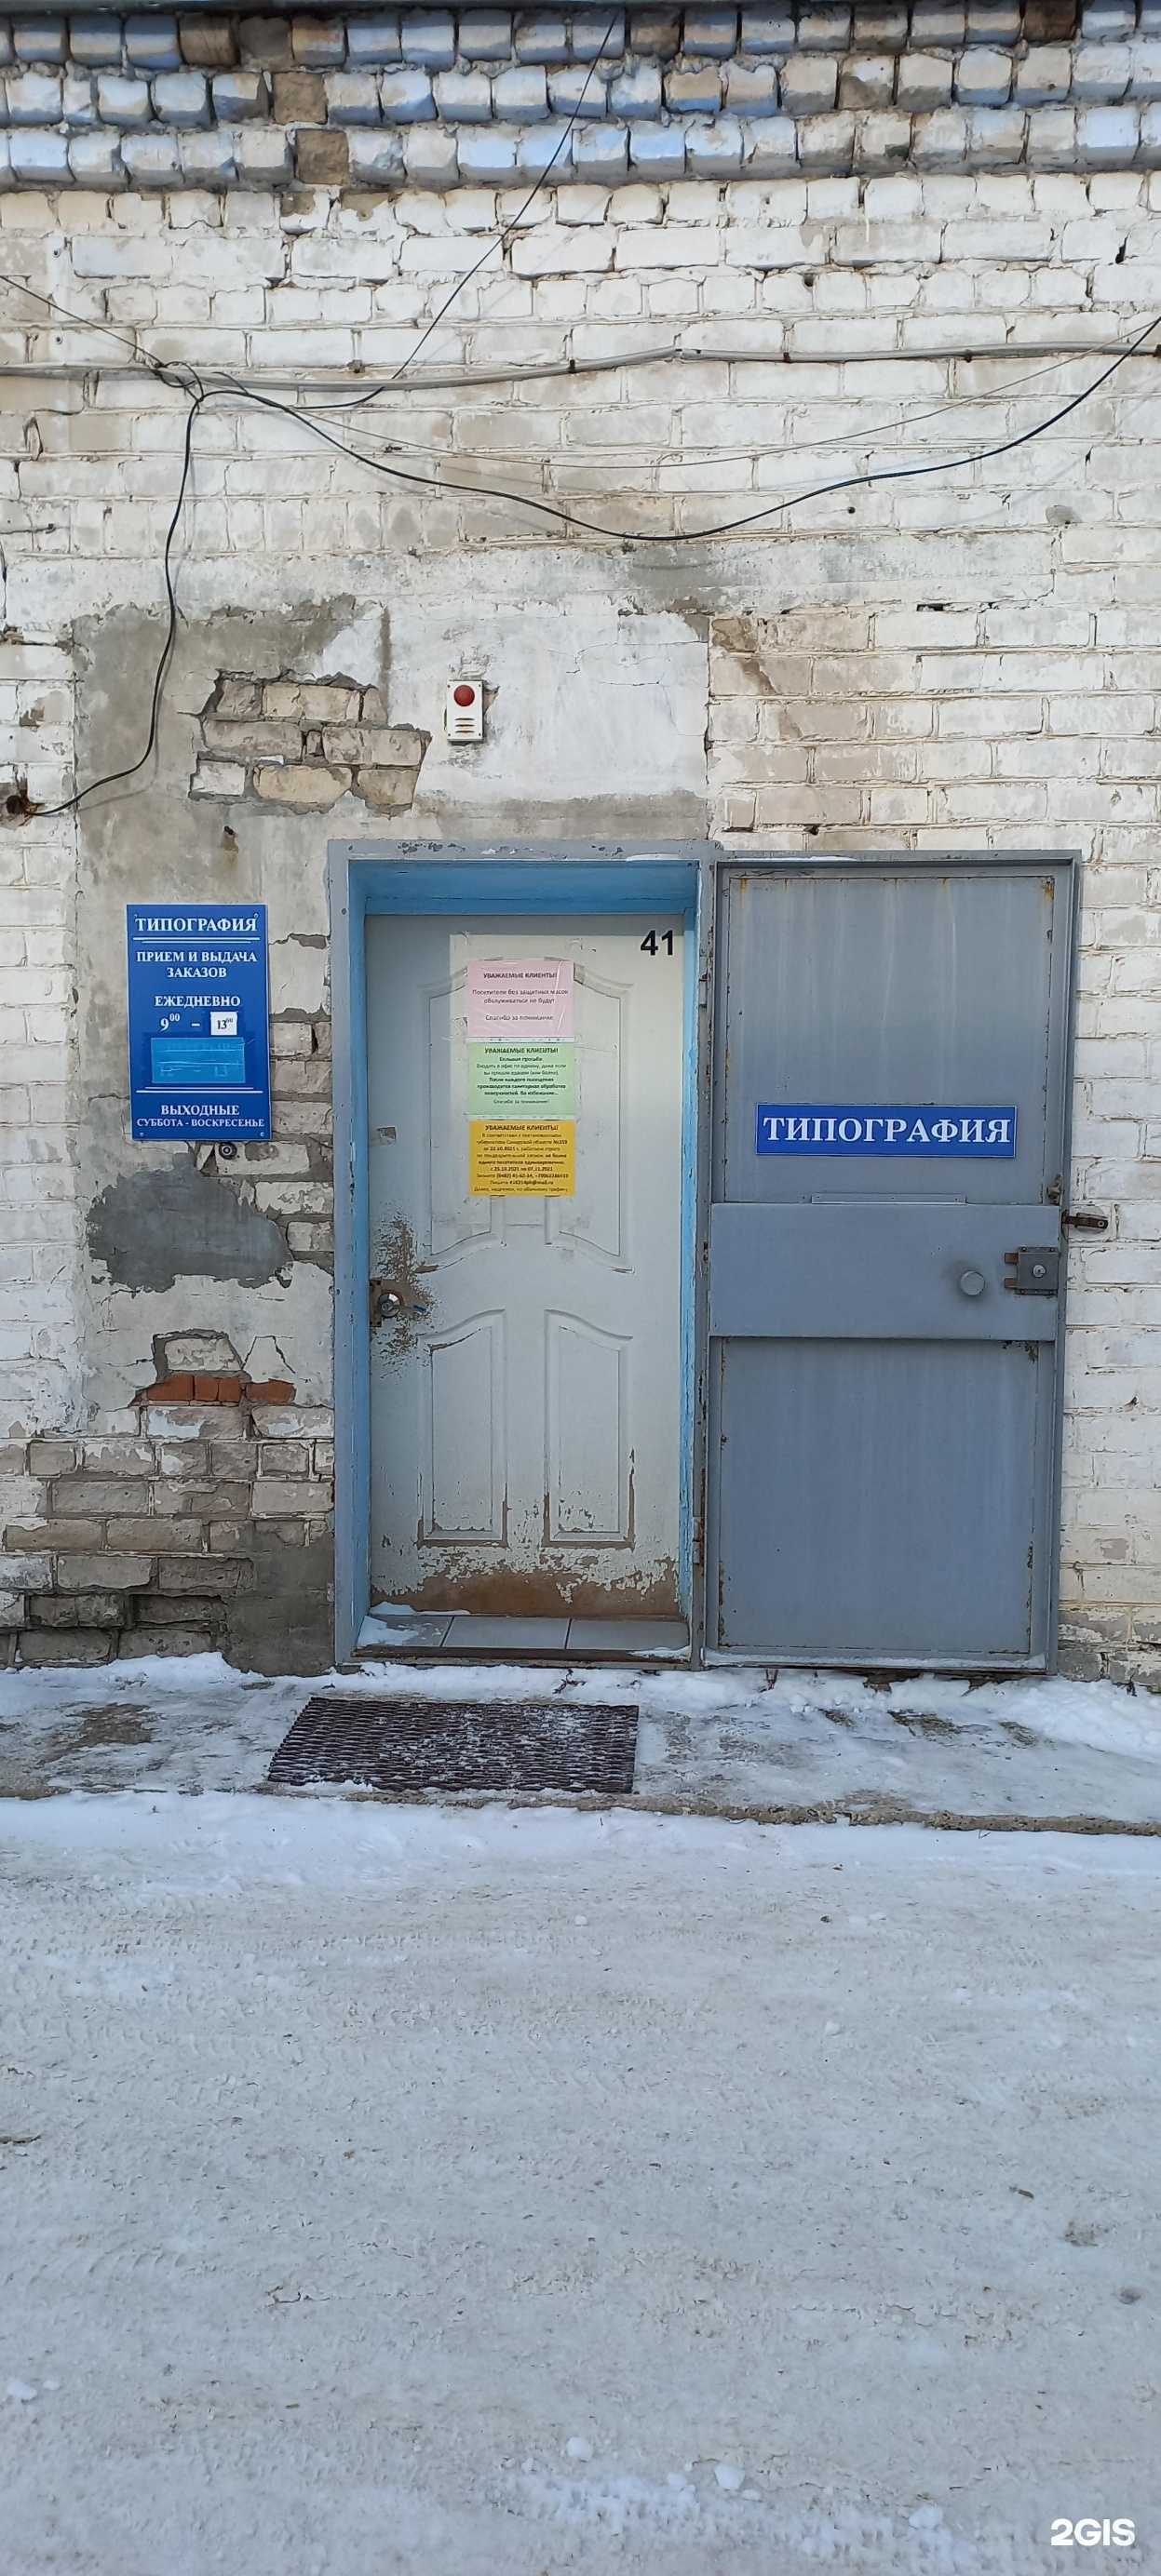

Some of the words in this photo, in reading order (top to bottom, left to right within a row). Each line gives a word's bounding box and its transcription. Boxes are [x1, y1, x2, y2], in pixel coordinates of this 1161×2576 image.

[135, 919, 257, 932] ТИПОГРАФИЯ
[640, 930, 675, 956] 41
[136, 952, 183, 962] ПРИЕМ
[189, 952, 197, 961] И
[202, 952, 257, 963] ВЫДАЧА
[167, 968, 226, 977] ЗАКАЗОВ
[155, 996, 240, 1008] ЕЖЕДНЕВНО
[161, 1106, 239, 1117] ВЫХОДНЫЕ
[137, 1119, 183, 1127] СУББОТА
[191, 1119, 264, 1127] ВОСКРЕСЕНЬЕ
[763, 1118, 1010, 1144] ТИПОГРАФИЯ
